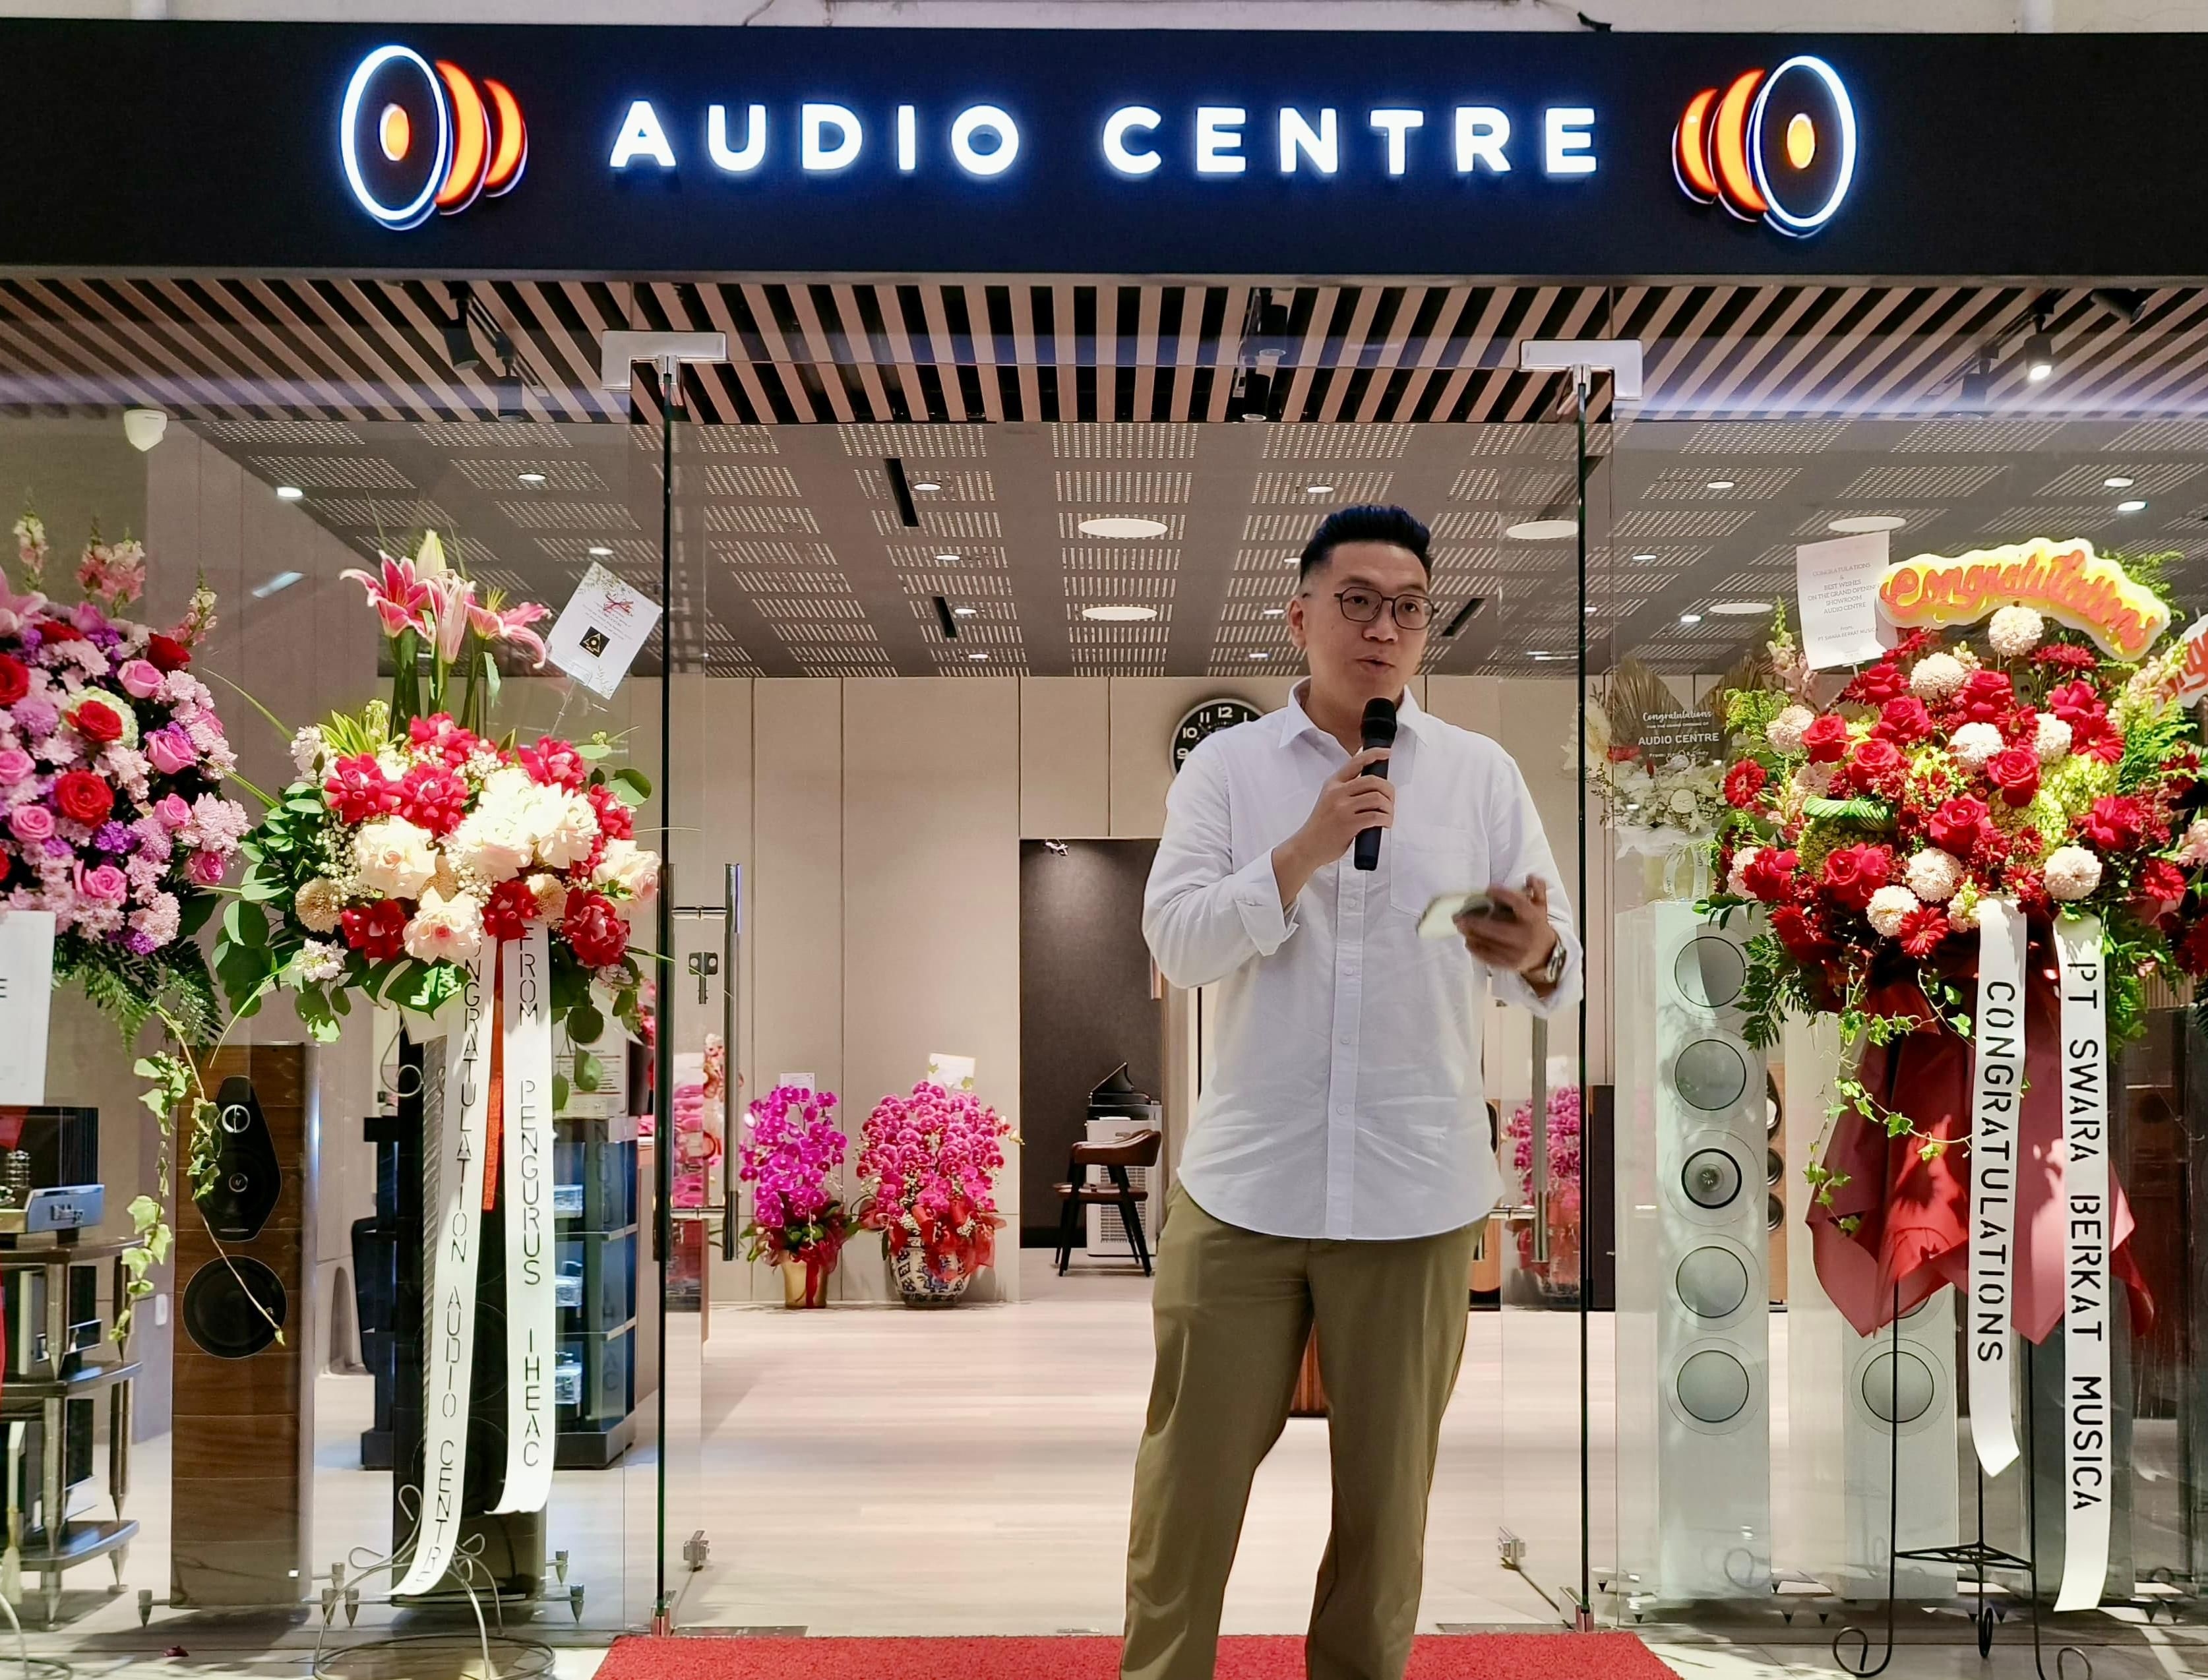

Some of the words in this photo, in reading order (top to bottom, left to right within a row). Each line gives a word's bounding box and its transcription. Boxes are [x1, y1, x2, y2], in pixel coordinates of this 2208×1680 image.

[609, 100, 1019, 175] AUDIO
[1103, 106, 1597, 175] CENTRE
[1812, 562, 1871, 576] CONGRATULATIONS
[1824, 606, 1843, 615] AUDIO
[1843, 601, 1866, 611] CENTRE
[1826, 595, 1862, 606] SHOWROOM
[1830, 589, 1852, 599] GRAND
[1182, 727, 1198, 739] 10
[1200, 711, 1210, 723] 11
[1217, 706, 1233, 718] 12
[1643, 710, 1713, 723] Congratulations
[1638, 735, 1672, 746] AUDIO
[1675, 733, 1719, 744] CENTRE
[2067, 963, 2097, 1009] PT
[451, 942, 482, 1263] NGRATULATION
[2069, 1039, 2101, 1162] SWARA
[520, 1080, 541, 1286] PENGURUS
[1977, 981, 2015, 1362] CONGRATULATIONS
[2070, 1195, 2102, 1342] BERKAT
[443, 1286, 462, 1418] AUDIO
[523, 1328, 540, 1467] IHEAC
[2071, 1376, 2103, 1510] MUSICA
